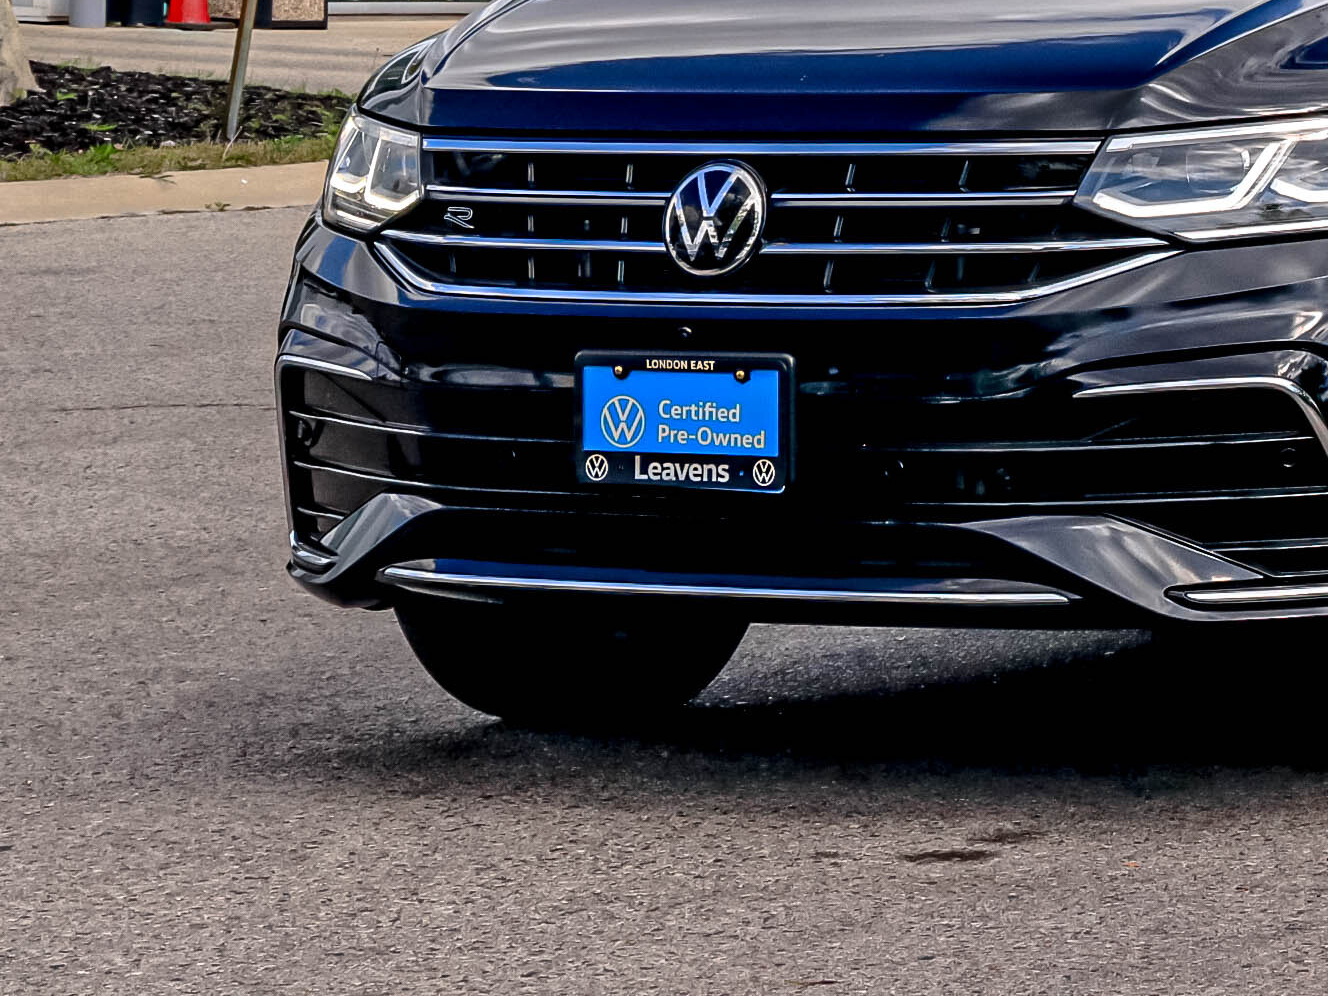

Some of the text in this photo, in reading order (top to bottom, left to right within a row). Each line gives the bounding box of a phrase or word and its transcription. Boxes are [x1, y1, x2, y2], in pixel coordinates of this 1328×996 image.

[646, 359, 716, 371] LONDON EAST
[658, 400, 740, 422] Certified
[657, 424, 766, 449] Pre-Owned
[634, 455, 730, 483] Leavens
